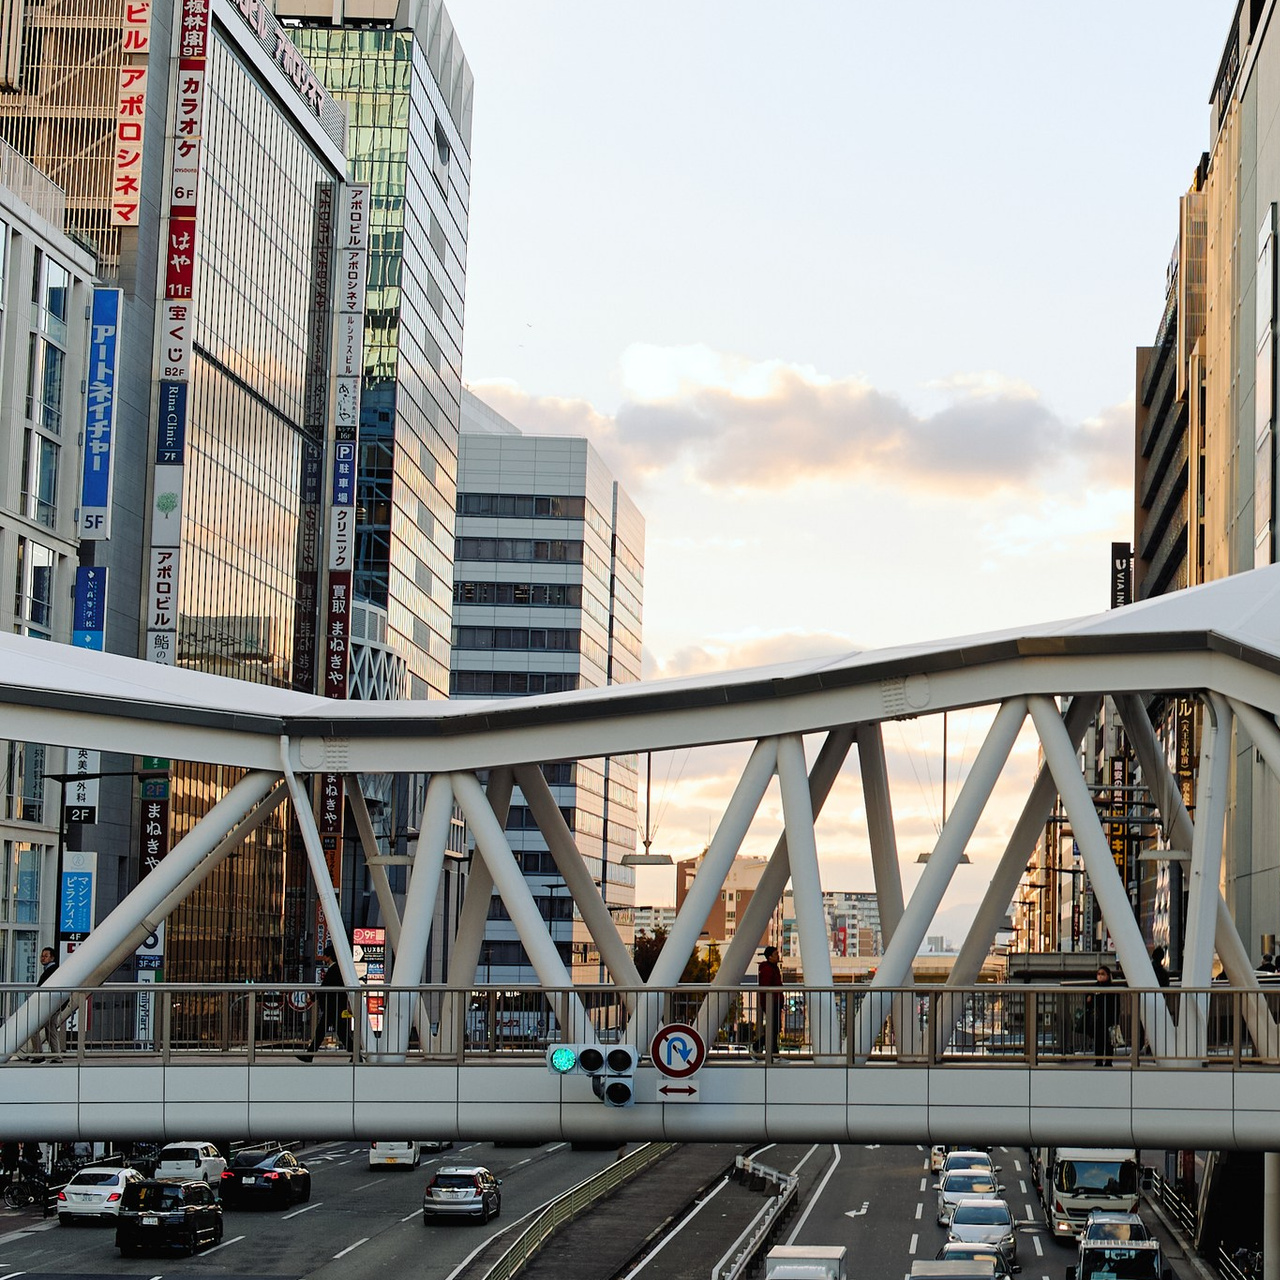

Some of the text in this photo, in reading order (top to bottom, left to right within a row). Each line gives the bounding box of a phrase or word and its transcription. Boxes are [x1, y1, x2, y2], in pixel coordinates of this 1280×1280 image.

[182, 46, 204, 57] 9F
[177, 76, 200, 158] カラオケ
[113, 65, 146, 223] アポロシネマ
[174, 186, 195, 200] 6F
[348, 188, 363, 247] アポロビル
[170, 231, 191, 273] はや
[168, 282, 191, 296] 11F
[346, 251, 359, 311] アポロシネマ
[167, 304, 188, 363] 宝くじ
[344, 315, 354, 375] ルシアスビル
[164, 366, 186, 378] B2F
[88, 325, 116, 471] アートネイチャー
[166, 385, 179, 448] Rina Clinic
[163, 450, 177, 463] 7F
[337, 462, 350, 504] 駐車場
[84, 515, 104, 530] 5F
[335, 510, 348, 567] クリニック
[153, 551, 174, 627] アポロビル
[1116, 572, 1125, 608] VIA IN
[153, 633, 170, 665] 鮨の
[328, 584, 346, 686] 買取 まねきや
[146, 784, 164, 796] 2F
[71, 808, 90, 821] 2F
[144, 802, 163, 870] まねきや
[63, 876, 78, 930] ピラティス
[77, 876, 90, 908] マシン
[69, 932, 82, 941] 4F
[364, 930, 377, 940] 9F
